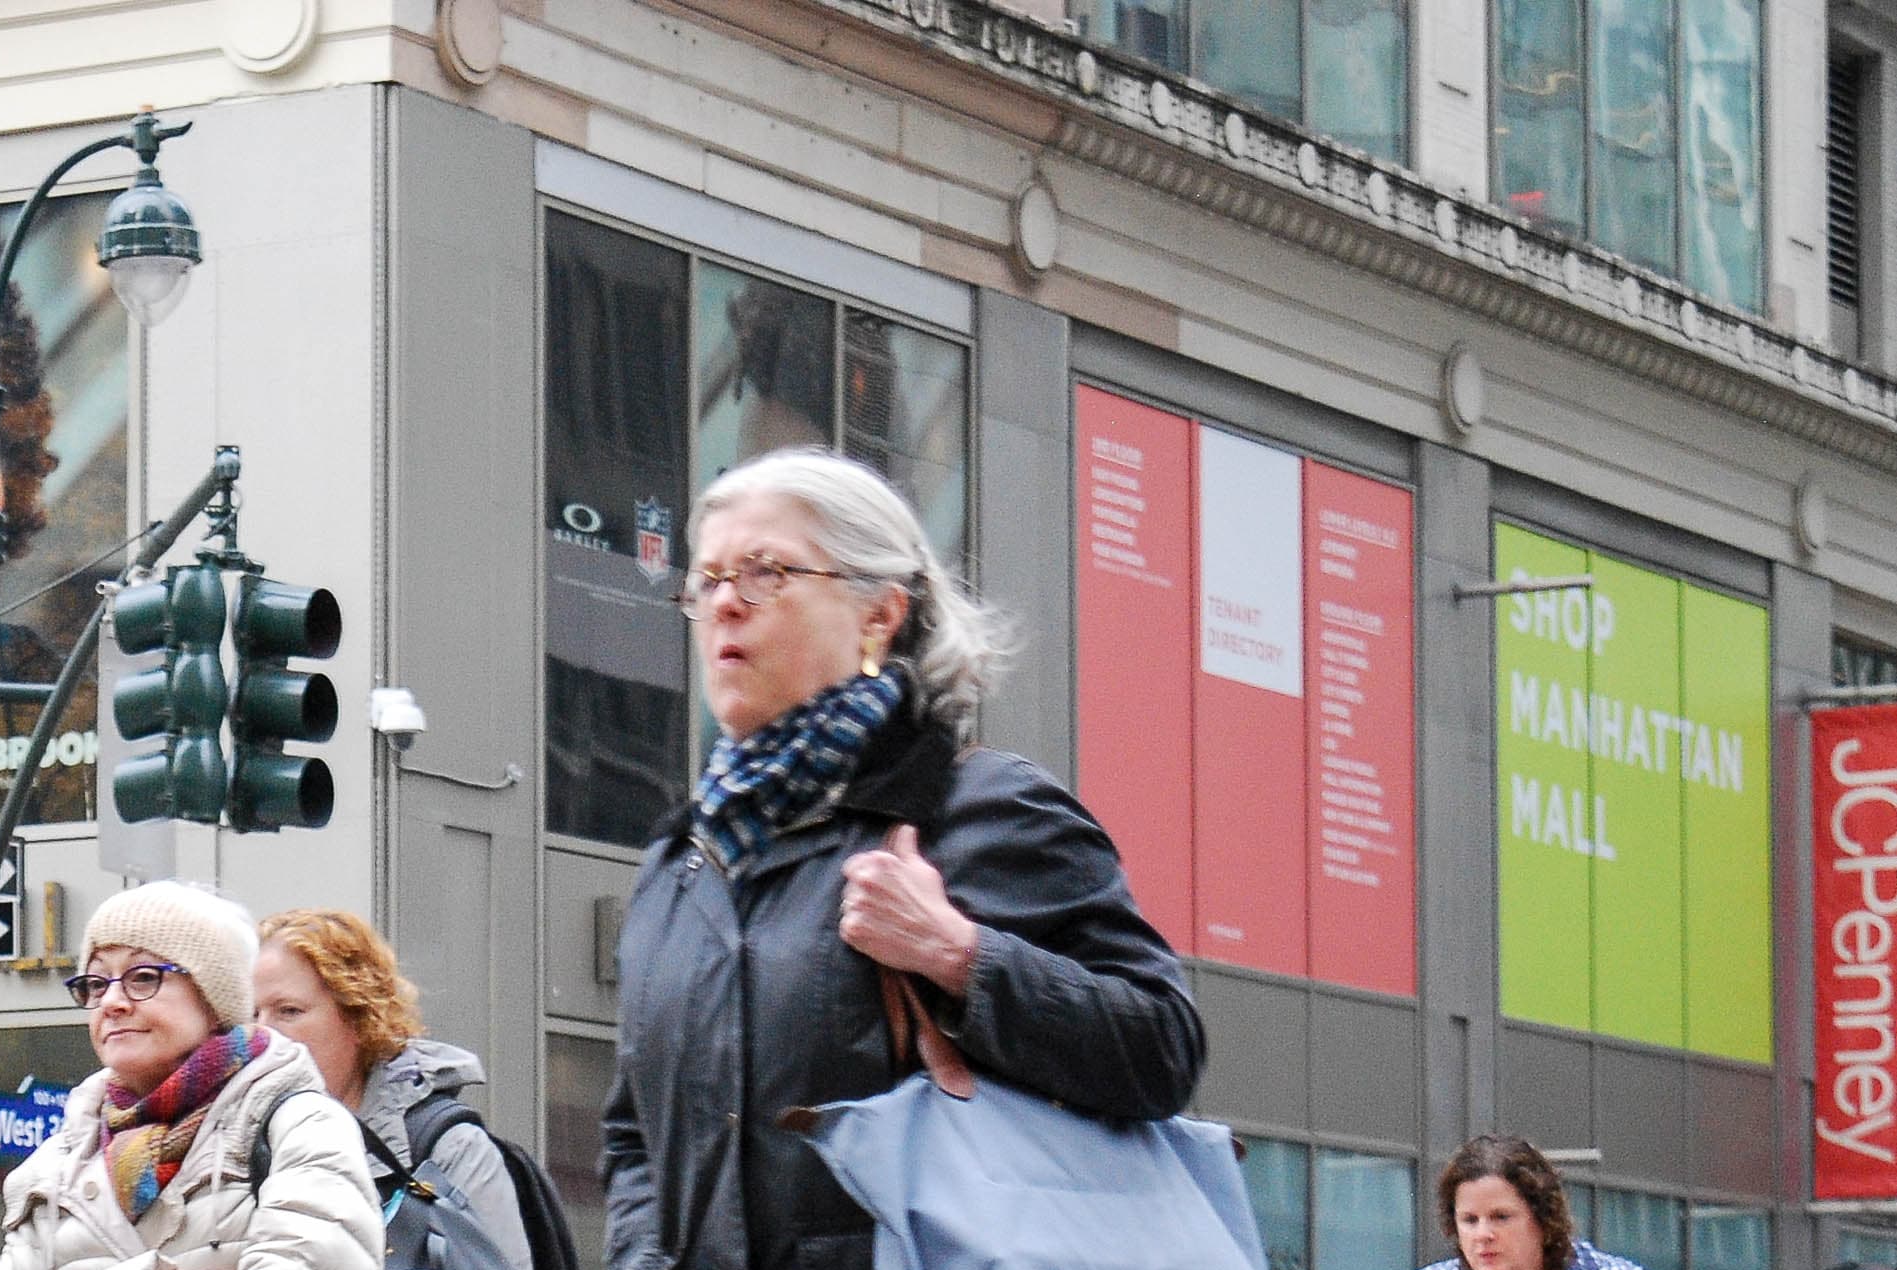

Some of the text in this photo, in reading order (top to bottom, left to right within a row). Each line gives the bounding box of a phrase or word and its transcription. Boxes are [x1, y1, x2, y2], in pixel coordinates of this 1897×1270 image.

[1208, 595, 1261, 626] TENANT
[1208, 627, 1283, 667] DIRECTORY
[1510, 567, 1615, 655] SHOP
[1510, 670, 1744, 792] MANHATTAN
[1510, 774, 1617, 861] MALL
[1816, 739, 1897, 1163] JCPenney
